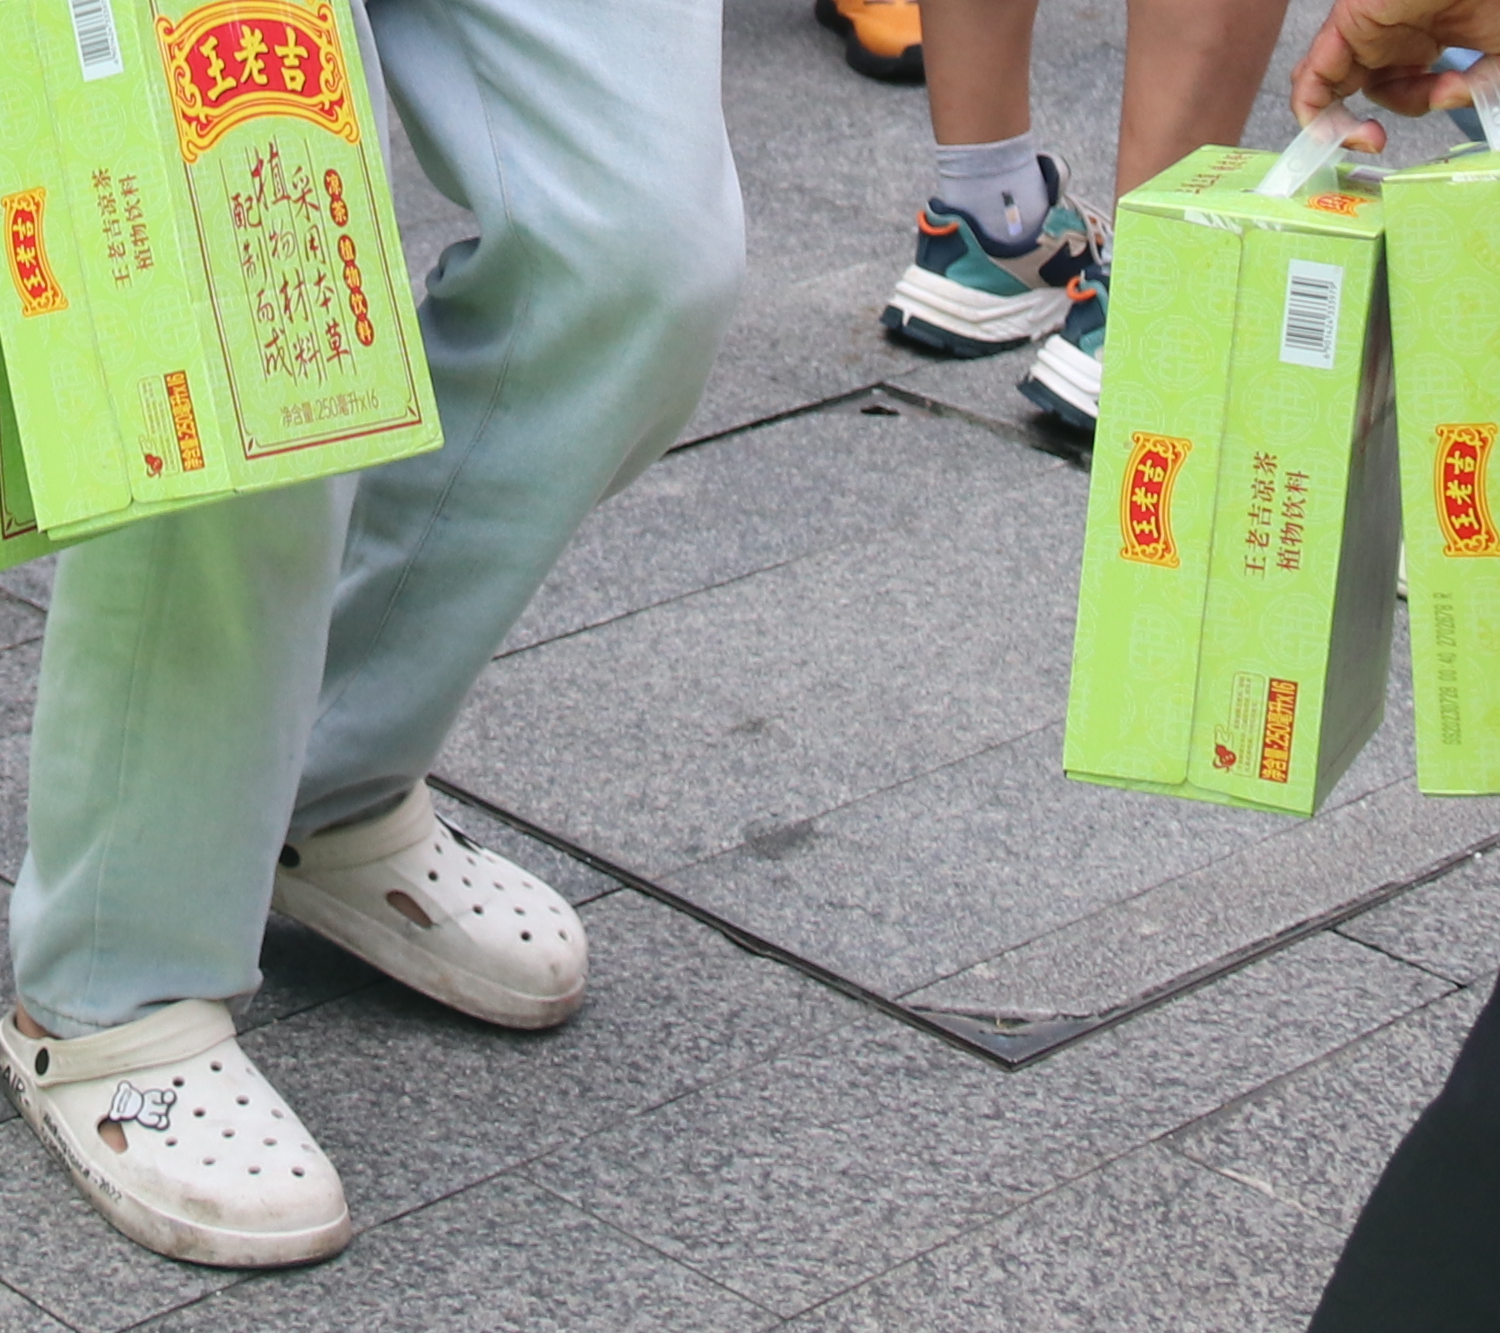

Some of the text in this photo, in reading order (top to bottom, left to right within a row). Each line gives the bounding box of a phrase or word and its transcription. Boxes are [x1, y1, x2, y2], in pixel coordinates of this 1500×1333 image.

[199, 26, 310, 100] 王老吉
[90, 167, 134, 289] 王老吉凉茶
[116, 174, 156, 270] 植物饮料
[325, 171, 348, 226] 凉茶
[10, 211, 46, 296] 王老吉
[339, 237, 374, 347] 植物饮料
[1131, 459, 1170, 543] 王老吉
[1242, 450, 1278, 579] 王老吉凉茶
[1276, 470, 1311, 573] 植物饮料
[1449, 449, 1481, 533] 王老吉
